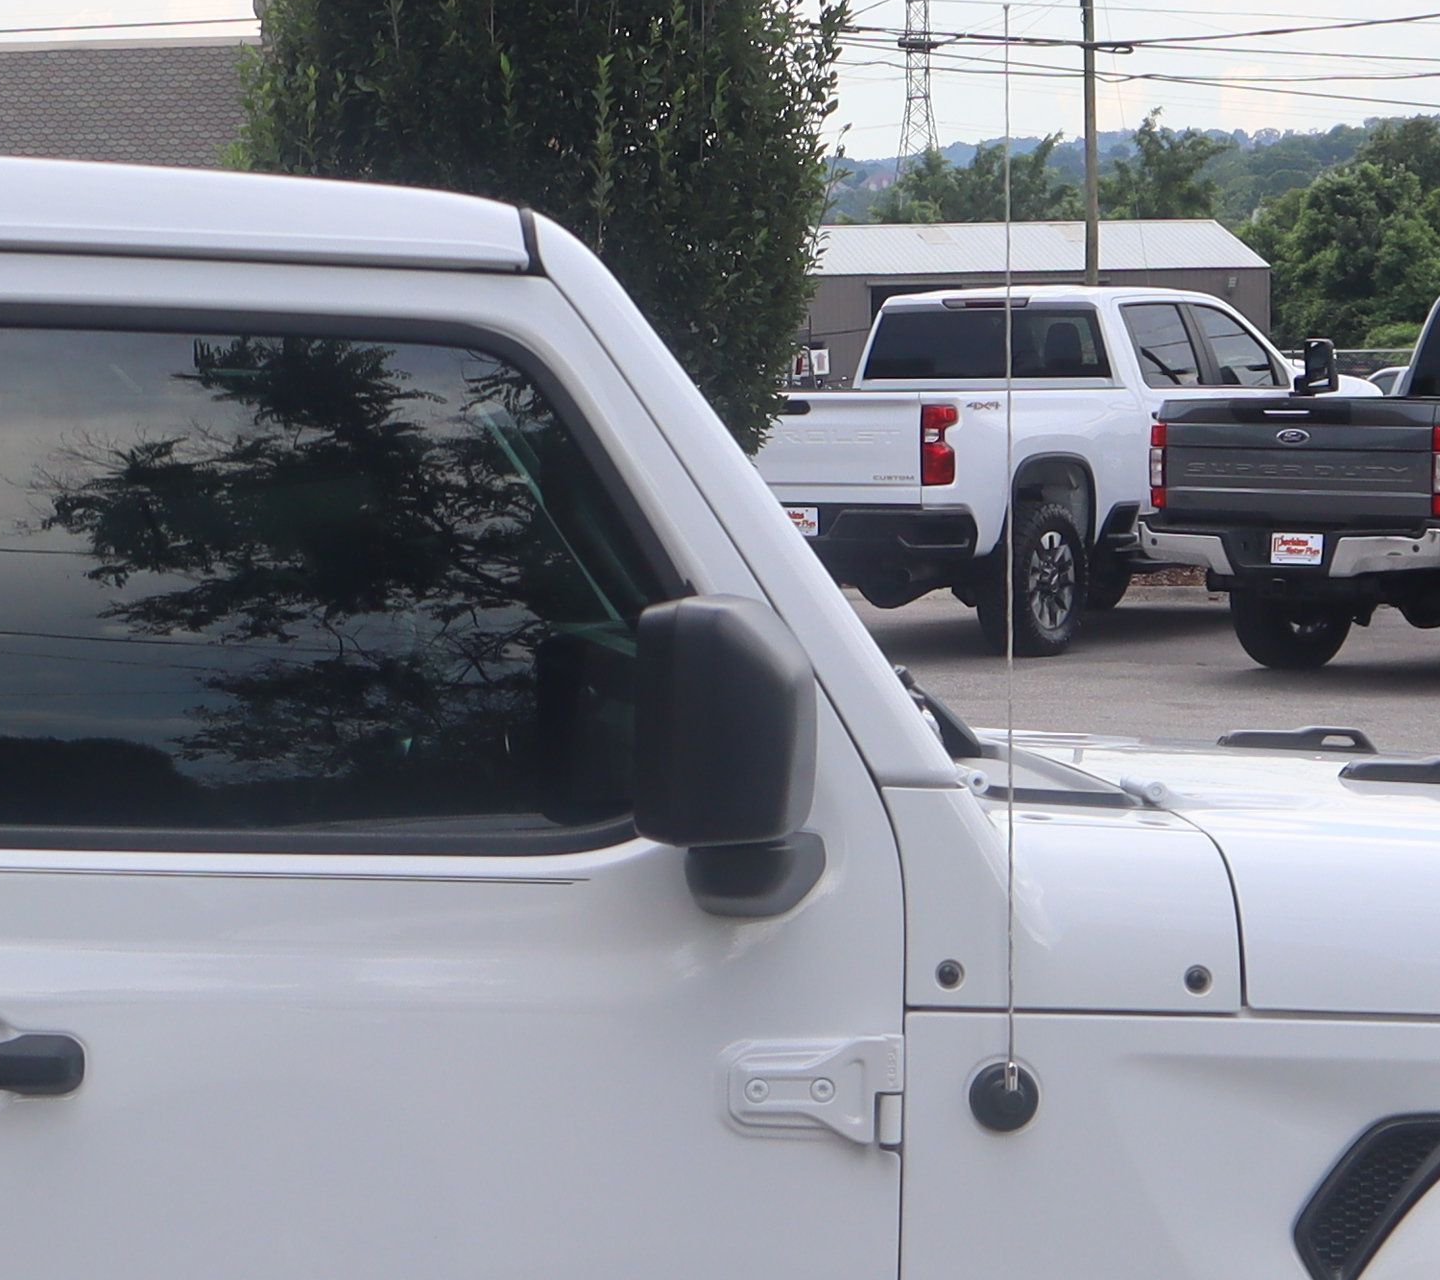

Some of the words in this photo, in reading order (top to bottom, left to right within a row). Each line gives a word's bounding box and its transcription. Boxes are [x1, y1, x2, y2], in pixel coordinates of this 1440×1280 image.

[1186, 461, 1303, 475] SUPER
[1314, 464, 1410, 476] DUTY
[872, 474, 916, 482] CUSTOM
